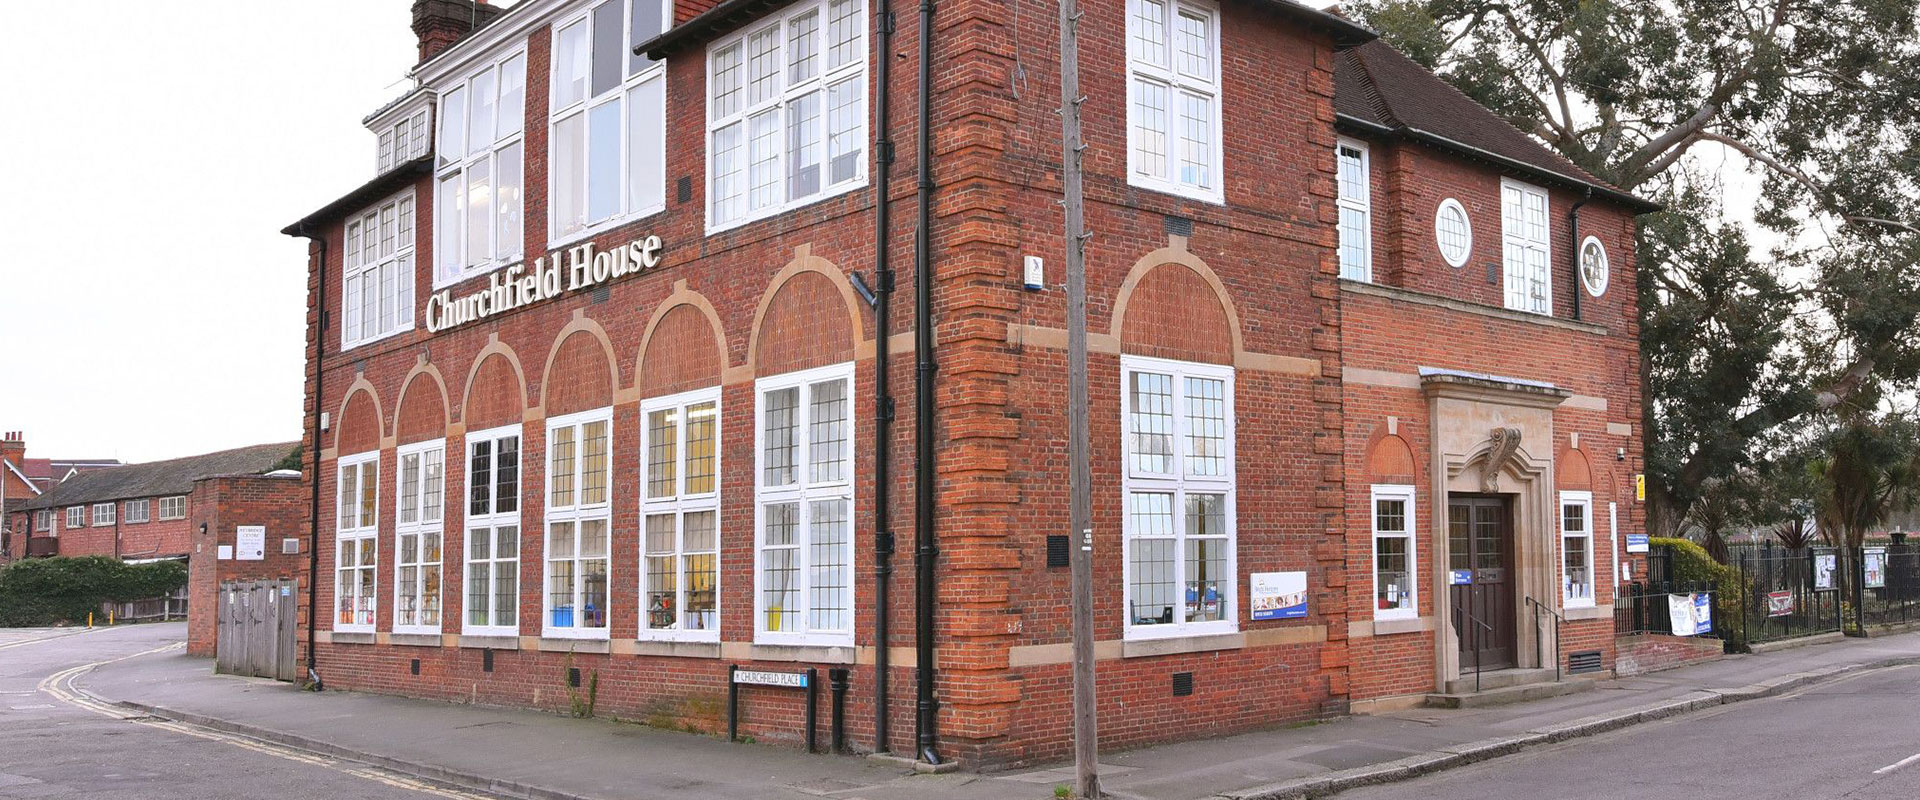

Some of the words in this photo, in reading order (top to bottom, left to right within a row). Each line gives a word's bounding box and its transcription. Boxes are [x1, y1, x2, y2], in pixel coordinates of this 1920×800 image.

[426, 250, 562, 333] Churchfield
[568, 235, 662, 291] House
[741, 672, 779, 683] CHURCHFIELD
[781, 673, 798, 685] PLACE
